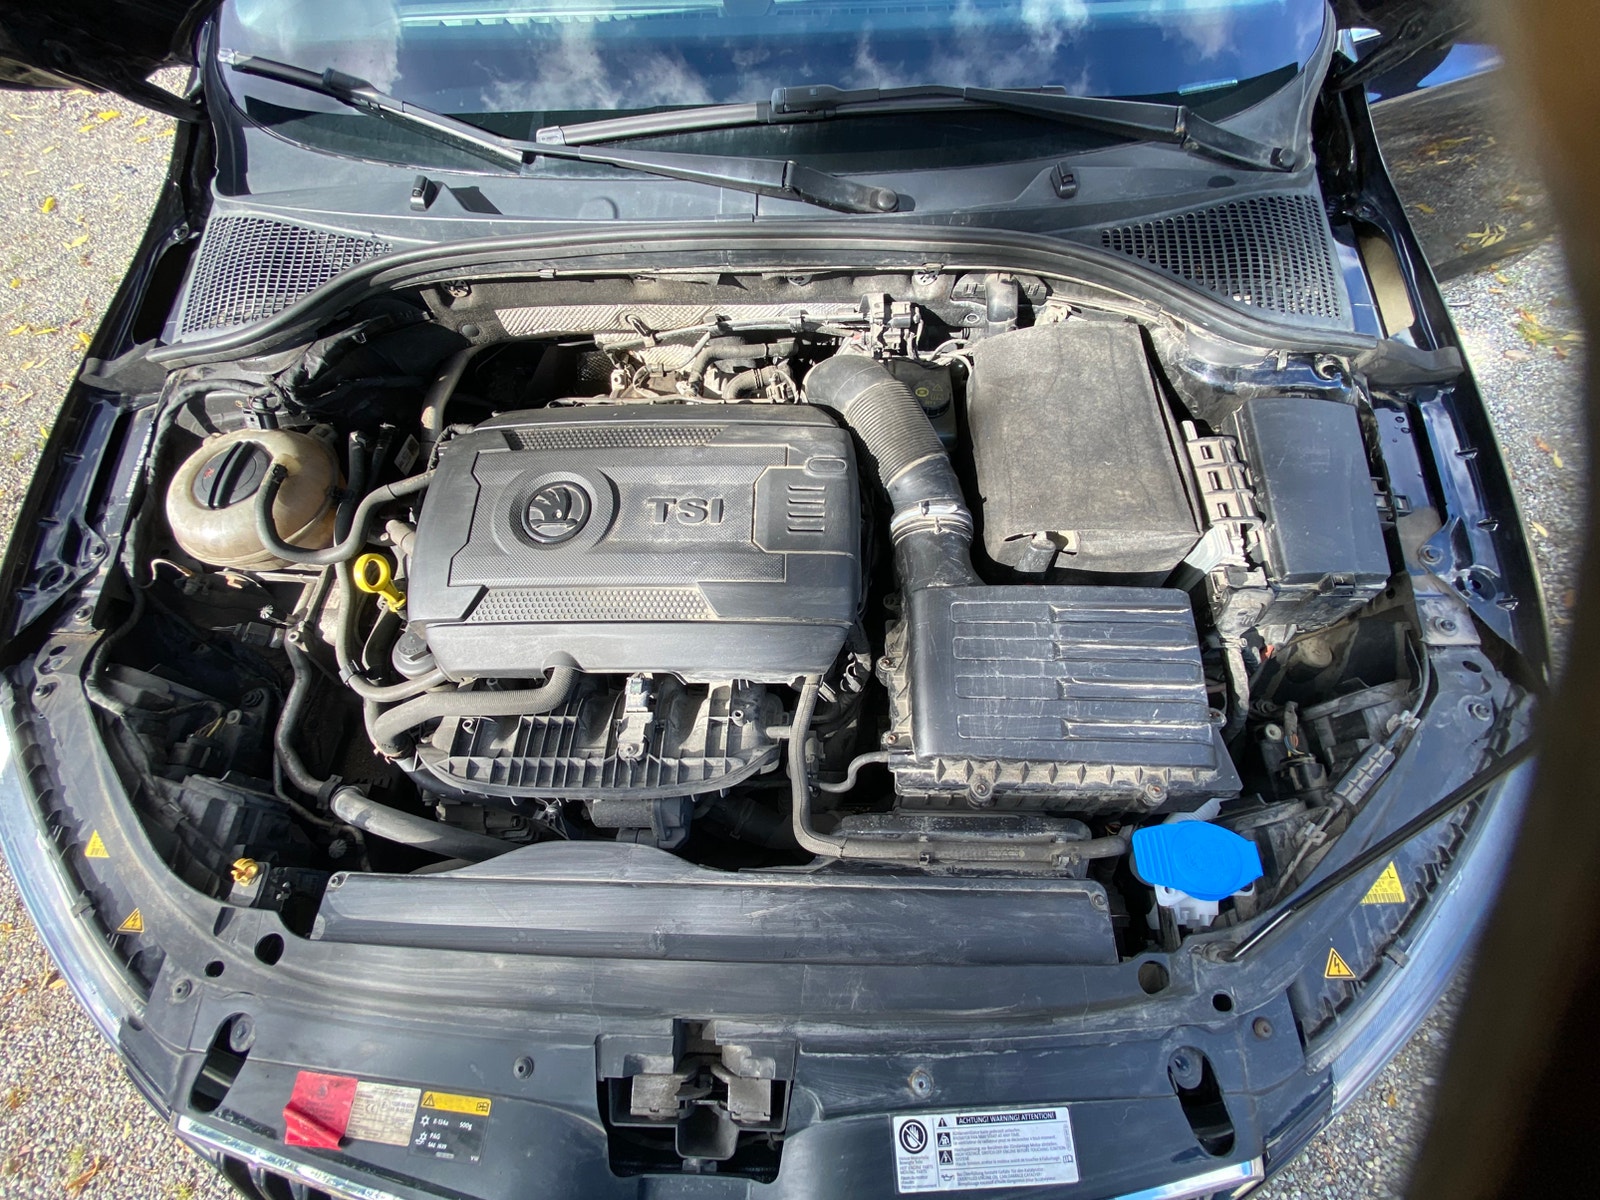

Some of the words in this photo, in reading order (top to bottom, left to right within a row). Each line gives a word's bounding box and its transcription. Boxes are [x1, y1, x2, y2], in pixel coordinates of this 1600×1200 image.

[646, 498, 724, 524] TSI
[1387, 870, 1395, 878] L
[958, 1116, 988, 1124] ACHTUNG!
[989, 1114, 1020, 1122] WARNING!
[1020, 1112, 1055, 1121] ATTENTION!
[459, 1121, 472, 1131] 500g
